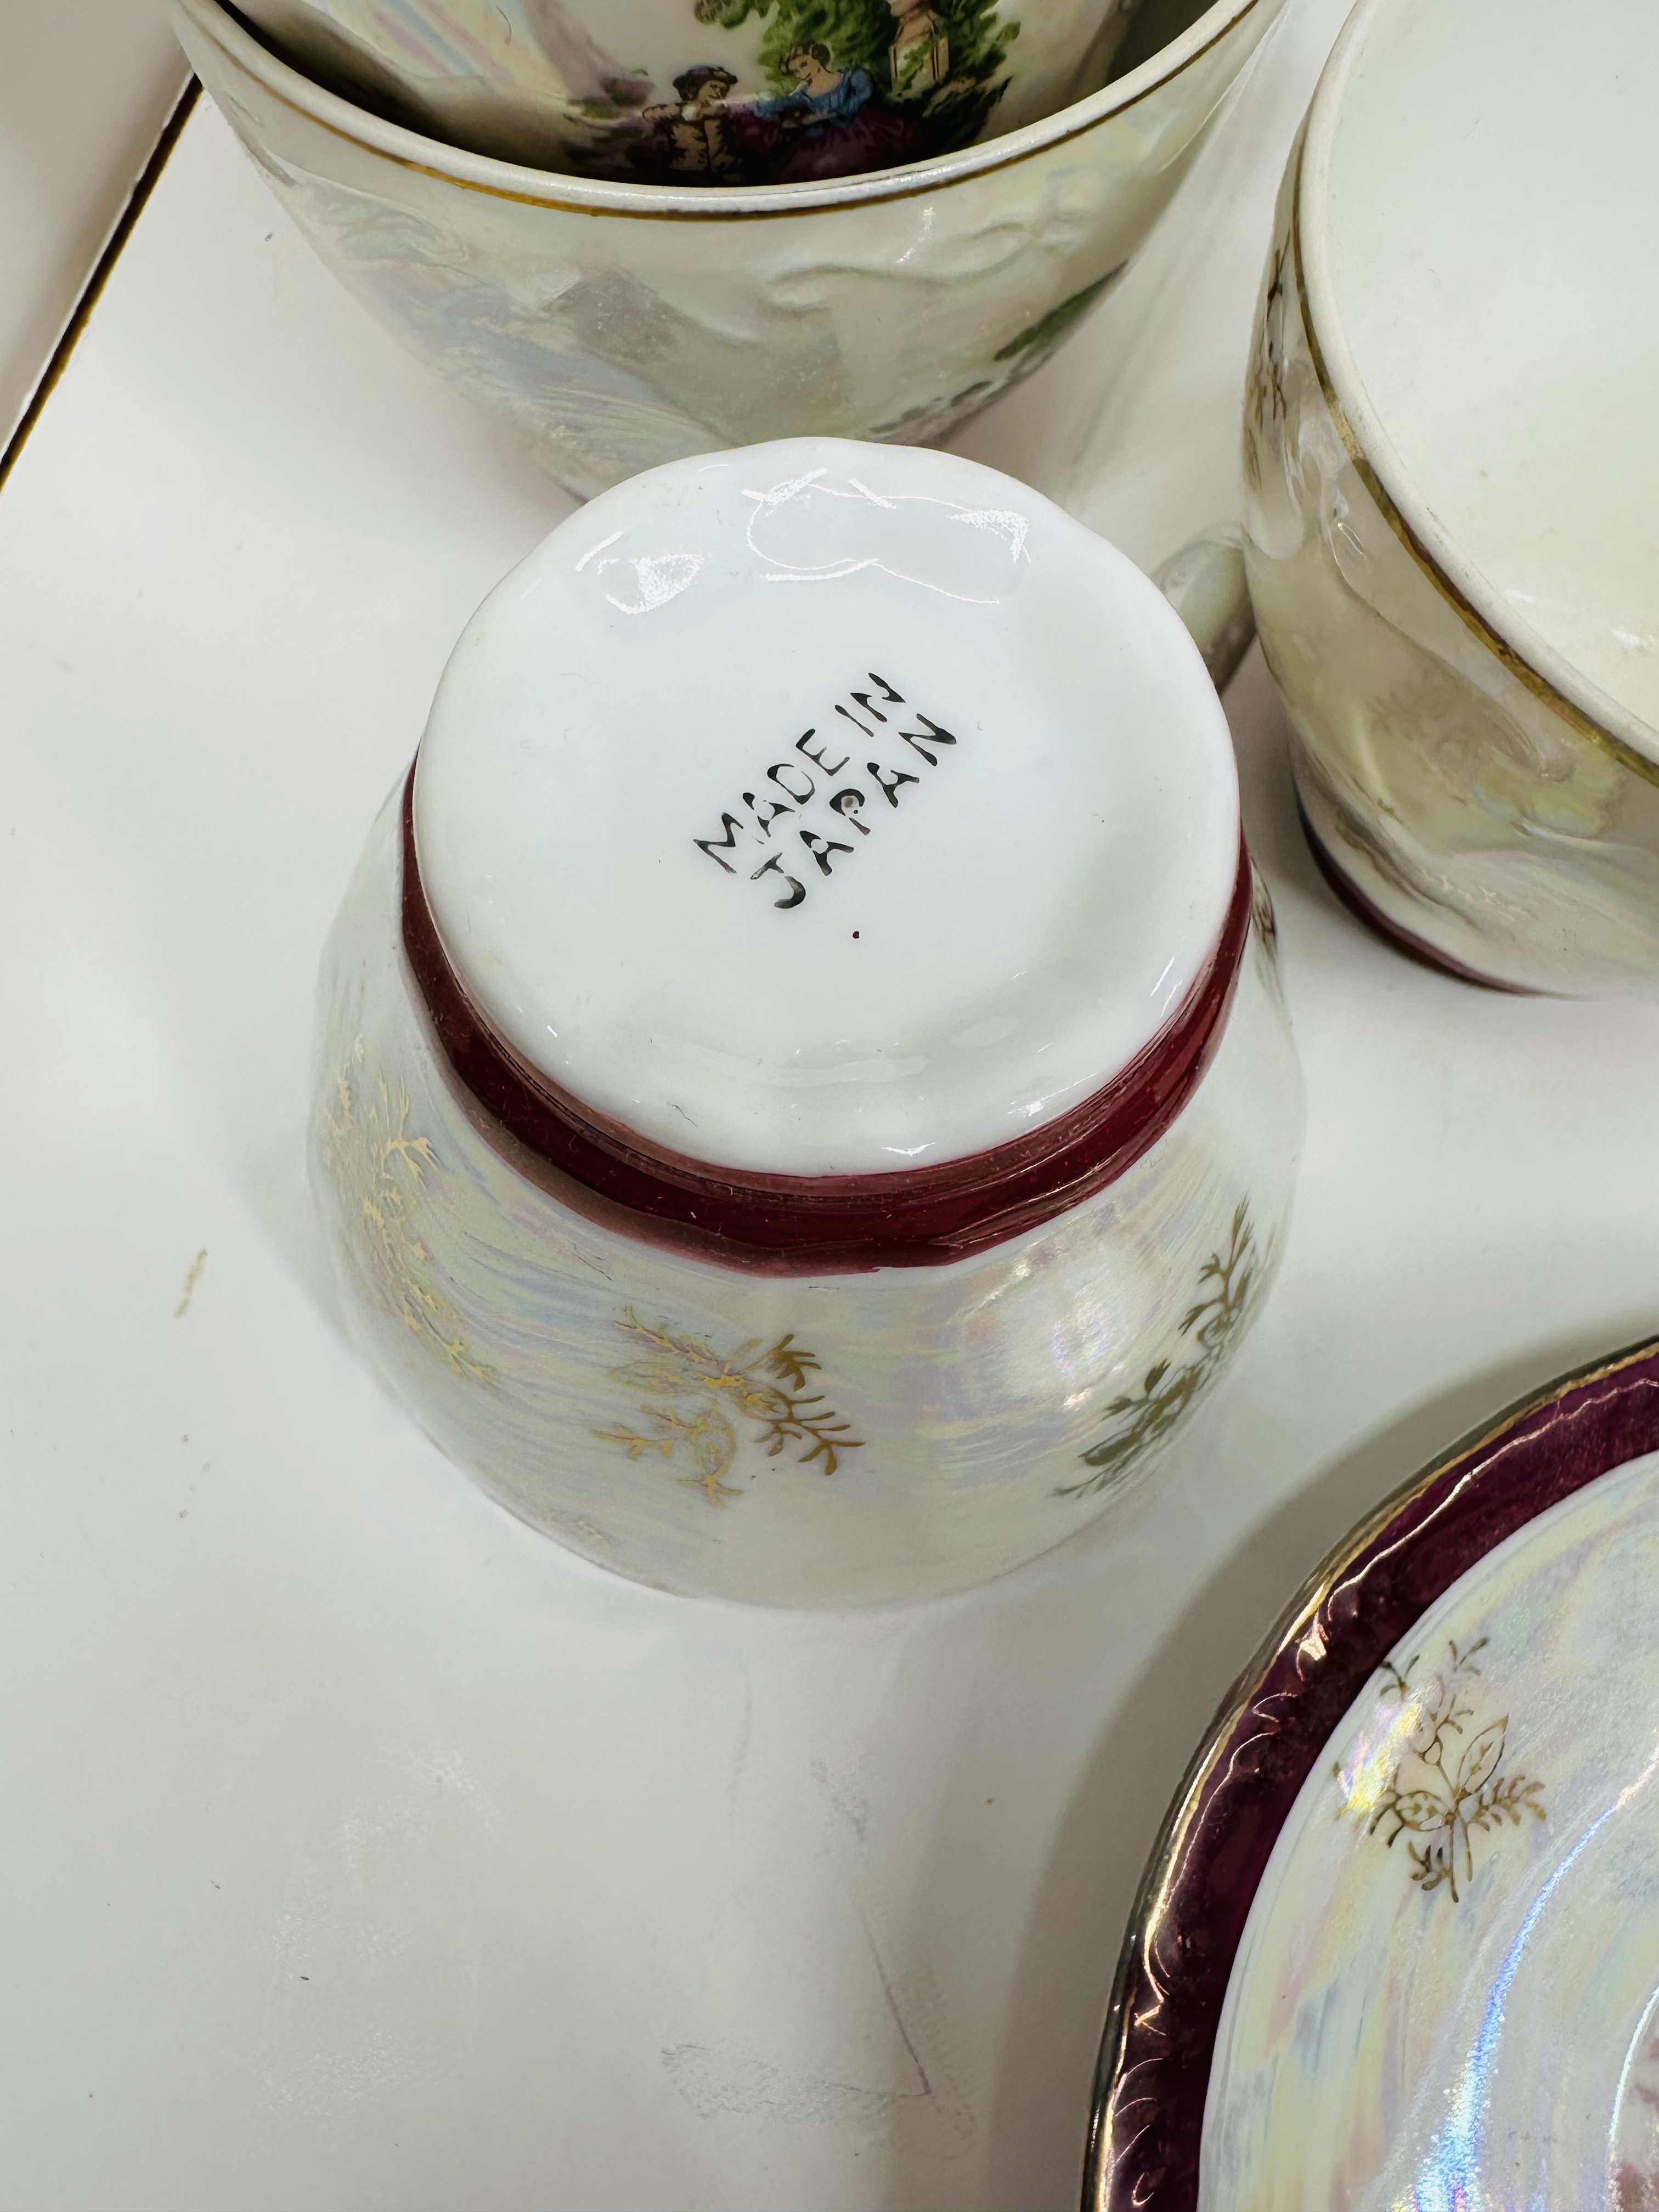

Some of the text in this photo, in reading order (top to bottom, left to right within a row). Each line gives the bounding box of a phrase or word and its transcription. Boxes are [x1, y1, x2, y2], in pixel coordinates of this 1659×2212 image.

[693, 673, 906, 873] MADE IN
[750, 713, 957, 909] JAPAN
